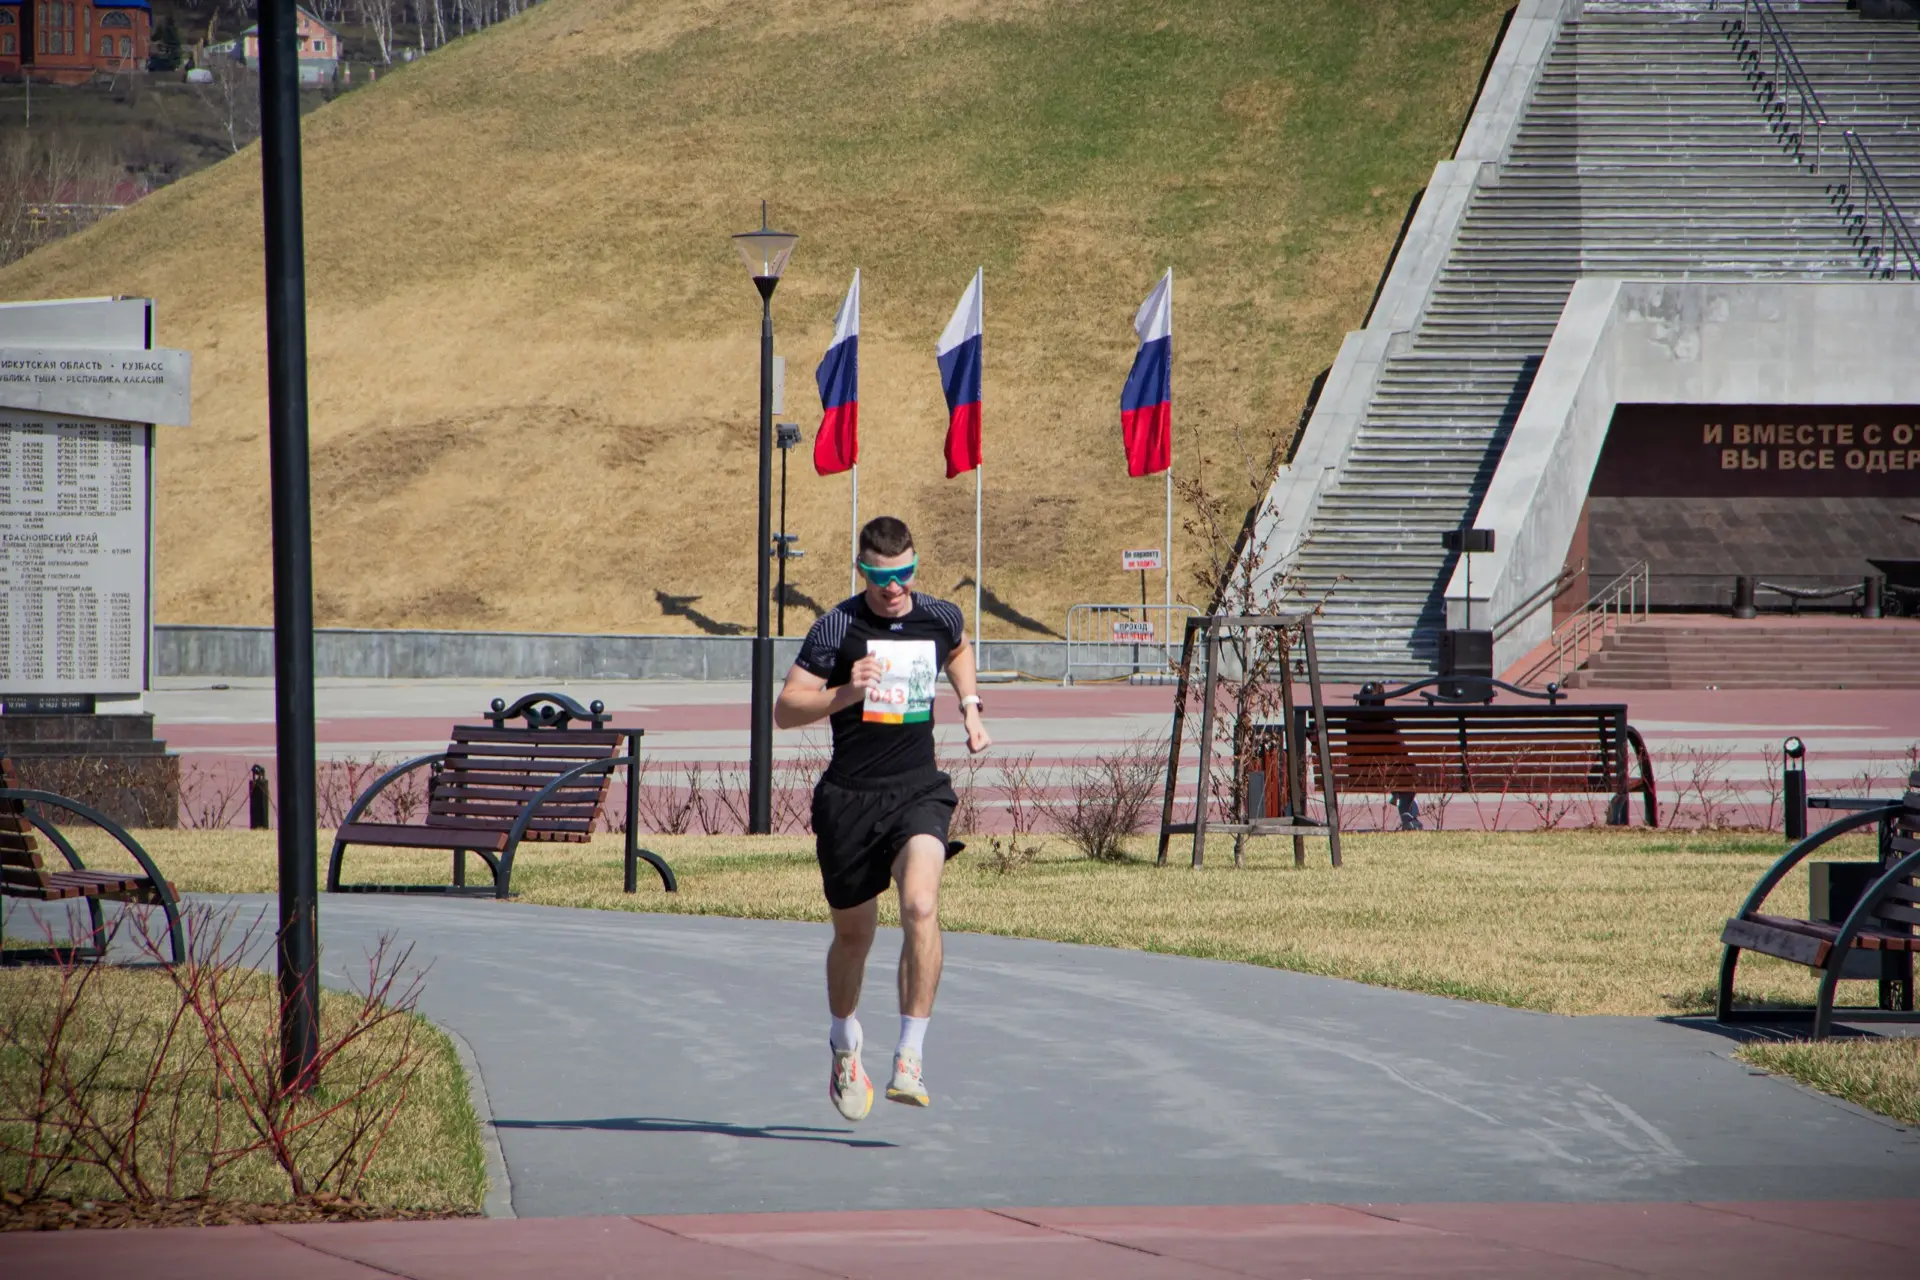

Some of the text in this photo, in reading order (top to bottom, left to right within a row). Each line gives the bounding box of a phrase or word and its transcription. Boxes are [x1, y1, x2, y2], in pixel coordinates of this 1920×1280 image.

[1, 360, 164, 371] ИРКУТСКАЯ ОБЛАСТЬ КУЗБАСС
[66, 375, 121, 384] РЕСПУБЛИКА
[123, 376, 164, 384] ХАКАСИЯ
[1703, 424, 1723, 445] И
[1733, 424, 1854, 445] ВМЕСТЕ
[1863, 424, 1882, 445] С
[1721, 449, 1768, 470] ВЫ
[1778, 449, 1836, 470] ВСЕ
[3, 532, 98, 542] КРАСНОЯРСКИЙ КРАЙ
[1120, 623, 1148, 631] ПРОХОД
[869, 686, 906, 705] 043
